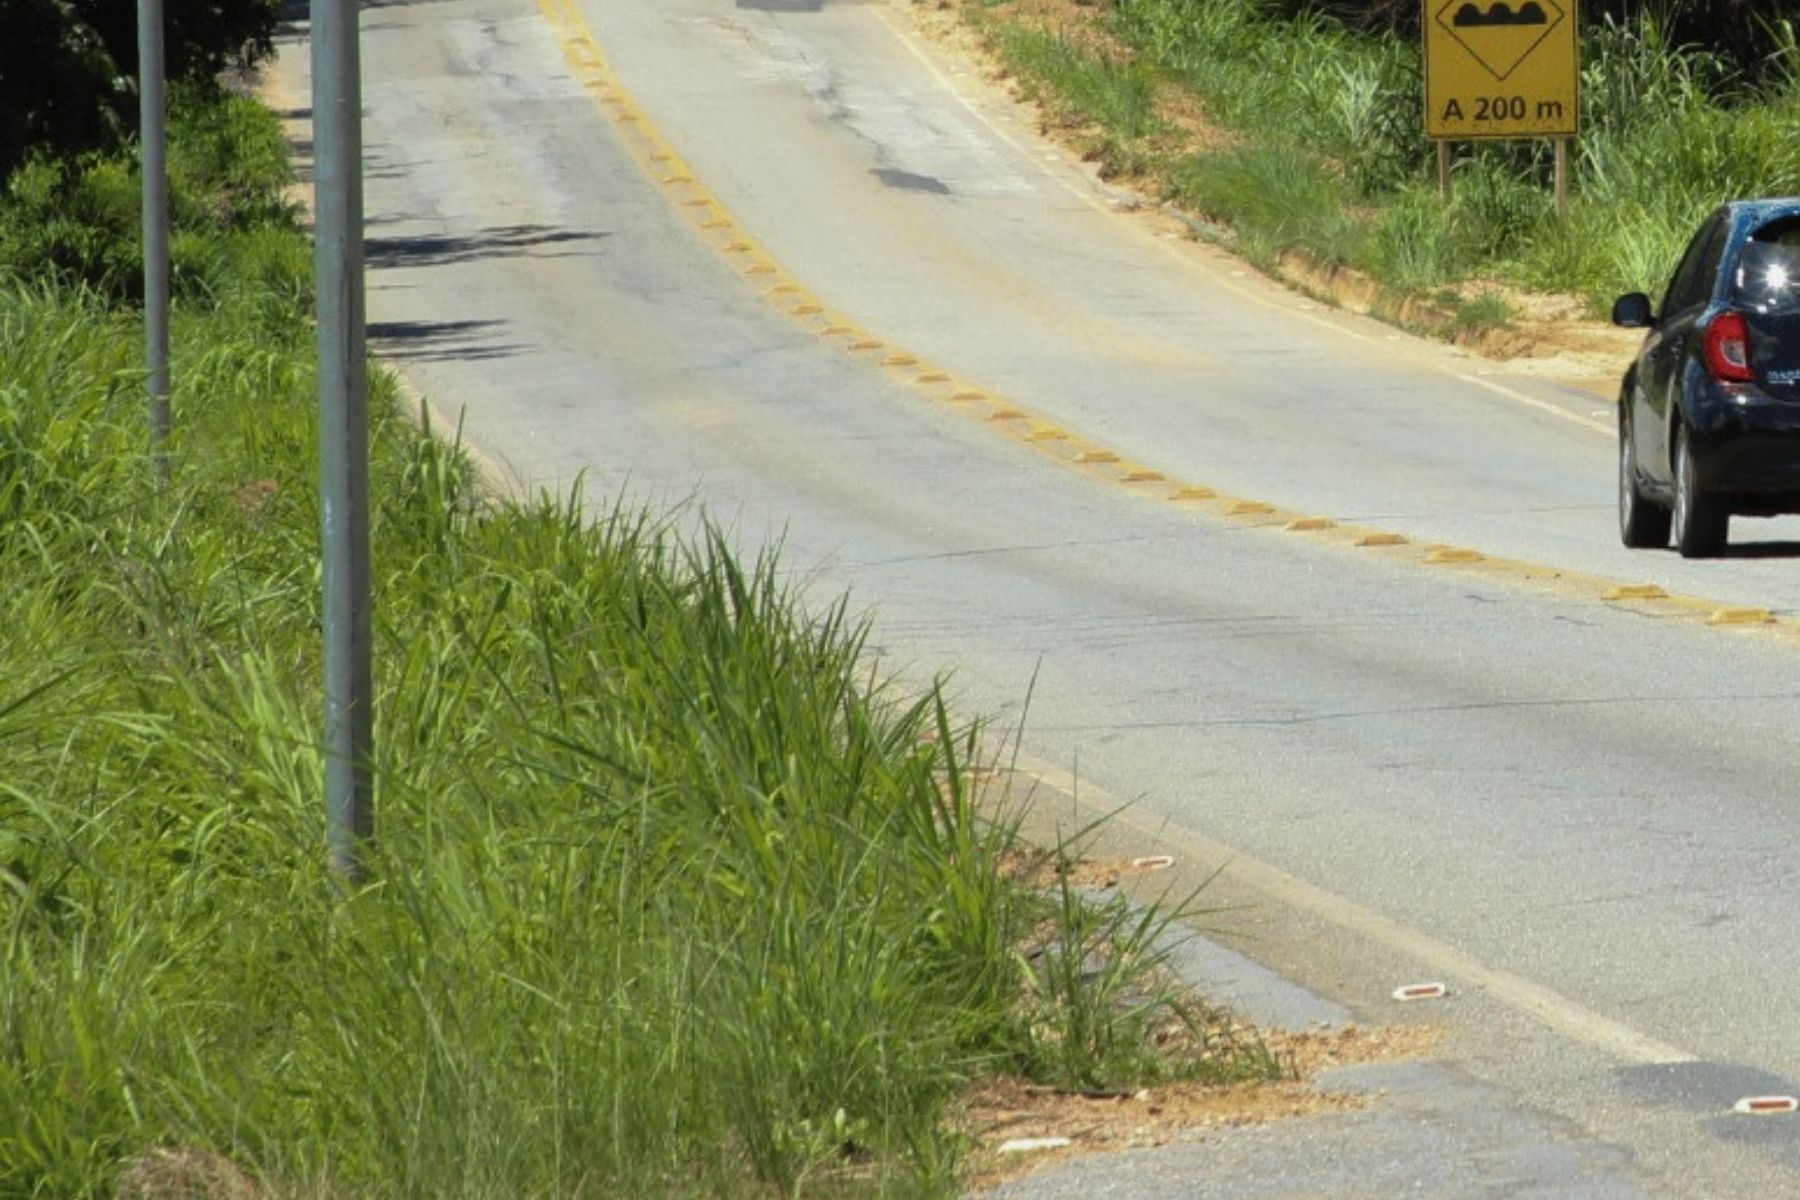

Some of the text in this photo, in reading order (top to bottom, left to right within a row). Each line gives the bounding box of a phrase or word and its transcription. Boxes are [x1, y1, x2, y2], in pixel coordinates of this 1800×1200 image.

[1443, 97, 1562, 121] A 200 m
